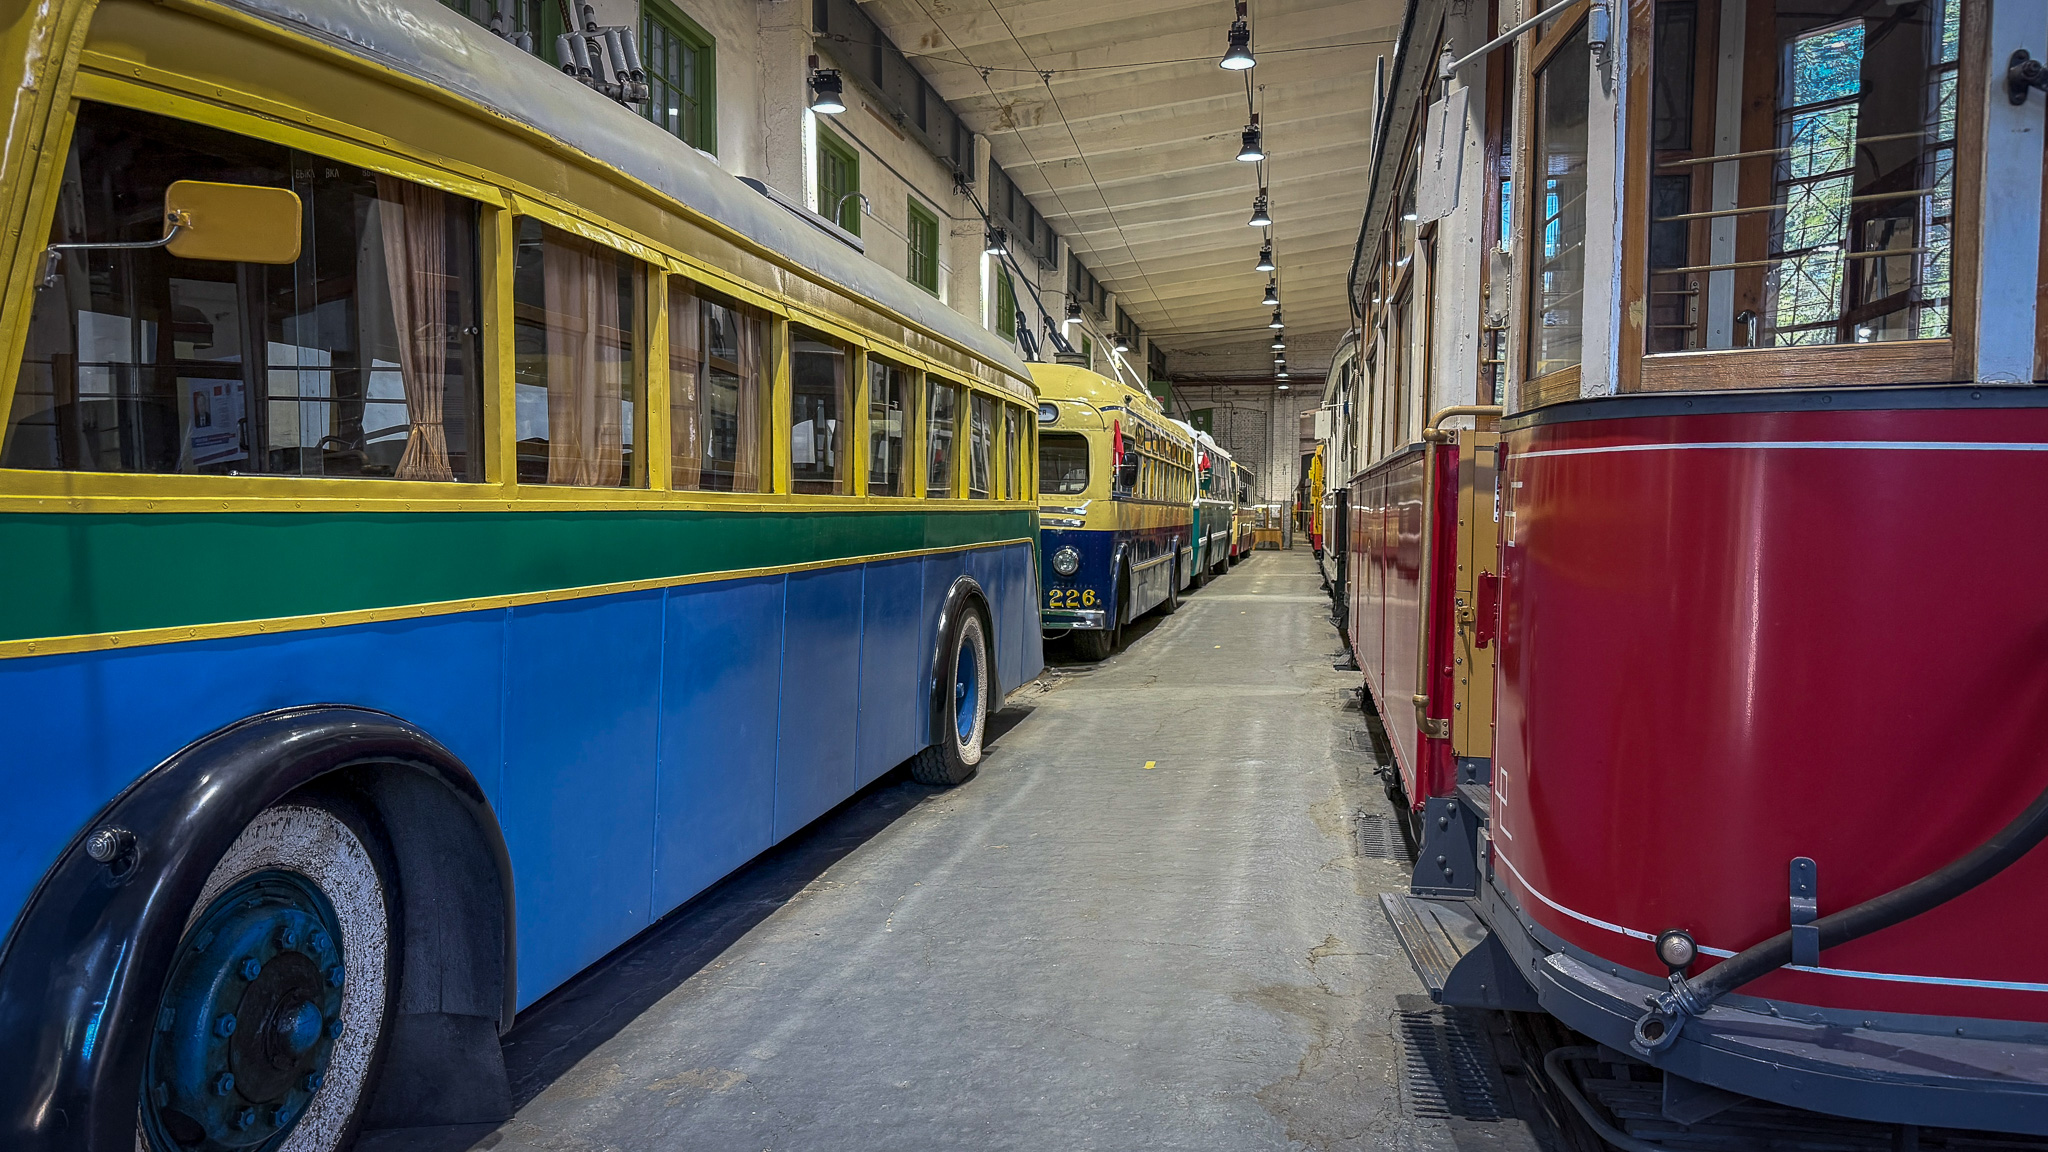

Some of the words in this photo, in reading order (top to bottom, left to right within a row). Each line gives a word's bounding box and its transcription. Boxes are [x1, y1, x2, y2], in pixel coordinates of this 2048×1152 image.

[295, 168, 316, 179] ВЫКЛ
[325, 167, 340, 179] ВКЛ
[1049, 589, 1096, 608] 226
